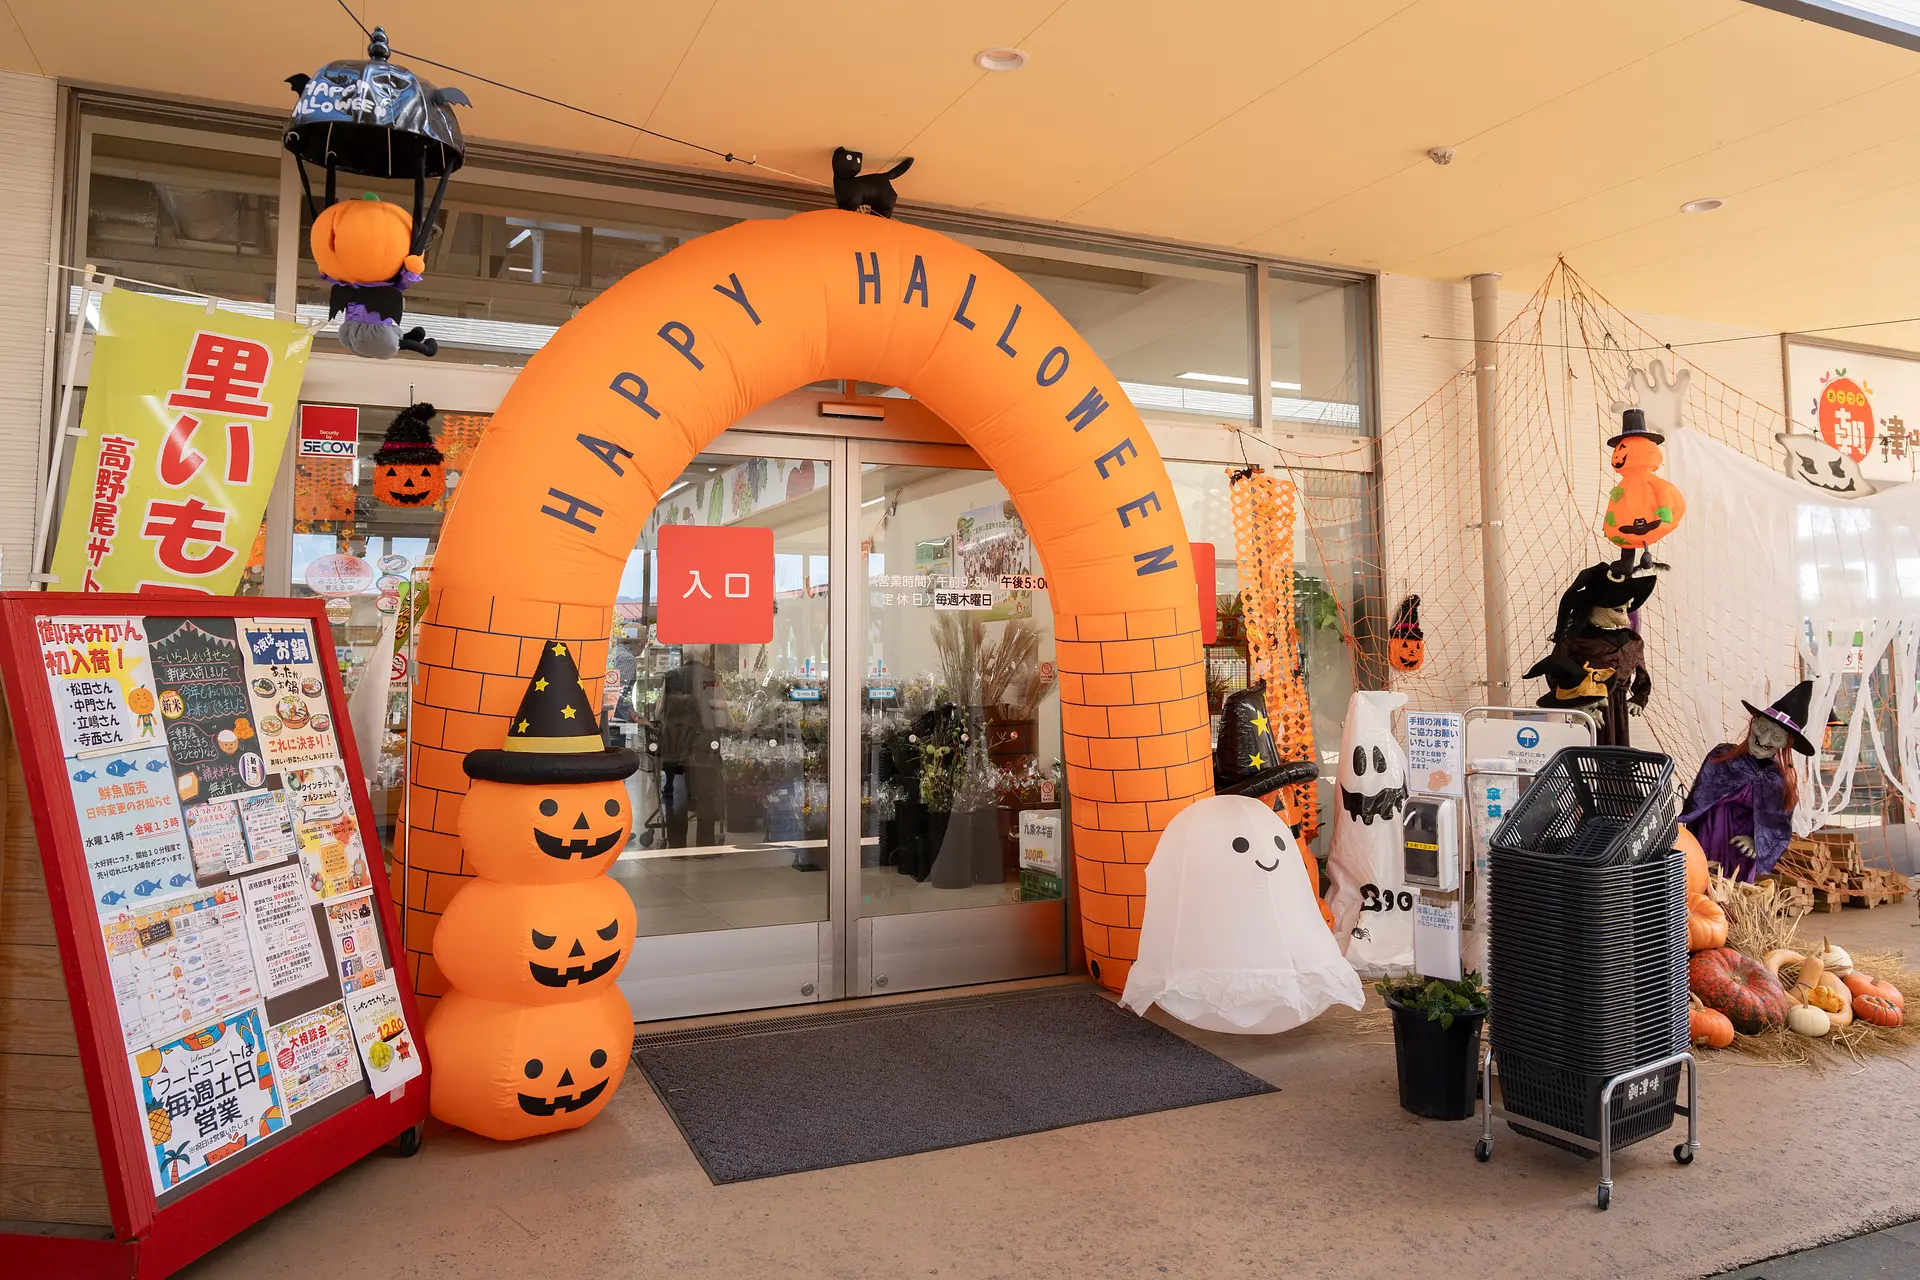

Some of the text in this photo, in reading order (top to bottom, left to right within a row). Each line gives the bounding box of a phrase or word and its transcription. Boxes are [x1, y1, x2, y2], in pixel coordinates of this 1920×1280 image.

[304, 79, 371, 98] HAPPY
[1829, 391, 1864, 405] あさつみ
[540, 251, 1179, 577] HAPPY HALLOWEEN
[303, 441, 354, 454] SECOM
[139, 330, 272, 595] 里いも
[683, 570, 750, 599] 入口
[936, 593, 992, 607] 毎週木曜日
[37, 619, 144, 646] 御浜みかん
[253, 633, 275, 656] 今夜は
[275, 638, 310, 661] お鍋
[44, 648, 125, 676] 初入荷！
[1409, 716, 1459, 727] 手指の消毒に
[1409, 727, 1459, 738] ご協力お願い
[268, 734, 331, 753] これに決まり！
[1409, 739, 1455, 749] いたします。
[97, 780, 149, 801] 鮮魚販売
[86, 795, 172, 820] 日時変更のお知らせ
[337, 910, 359, 924] SNS
[289, 1024, 328, 1050] 大相談会
[157, 1043, 255, 1096] フードコートは
[165, 1061, 257, 1121] 毎週土日
[194, 1095, 243, 1138] 営業
